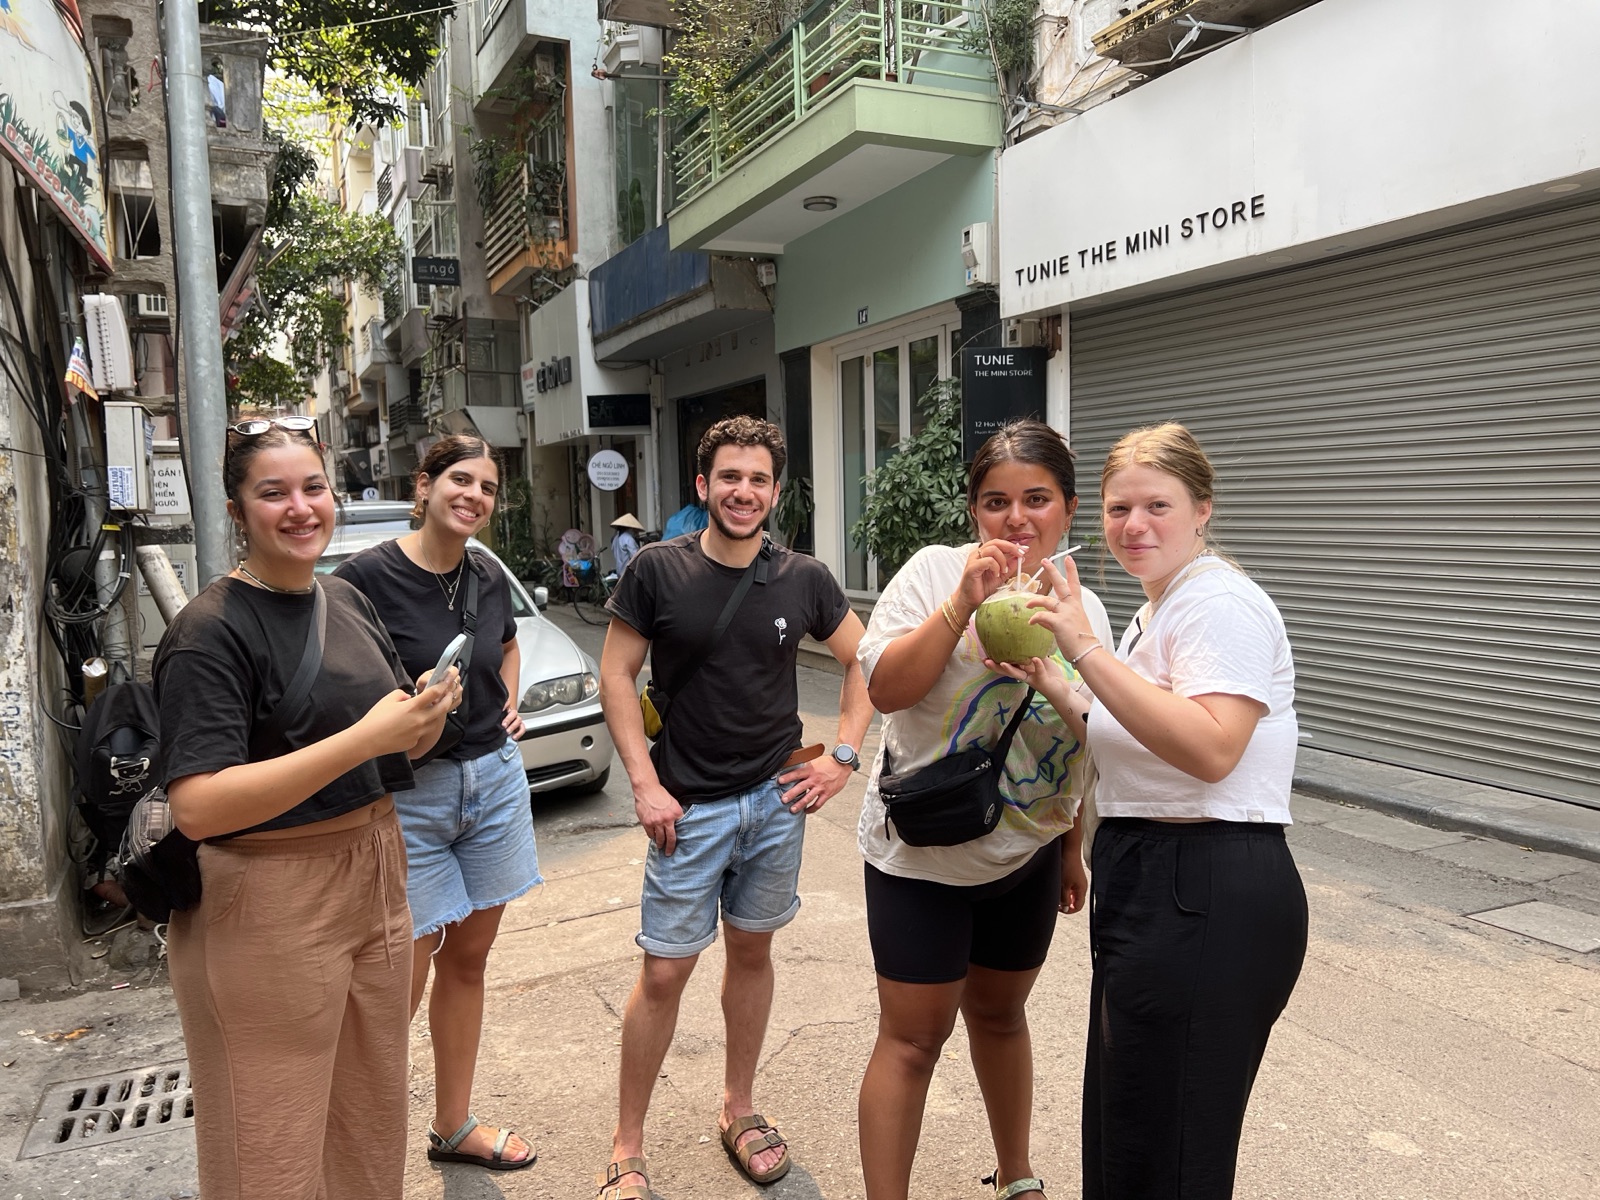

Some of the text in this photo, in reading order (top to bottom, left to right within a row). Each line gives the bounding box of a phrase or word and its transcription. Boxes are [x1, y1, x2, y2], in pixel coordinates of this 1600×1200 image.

[1015, 194, 1266, 287] TUNIE THE MINI STORE
[974, 354, 1014, 366] TUNIE
